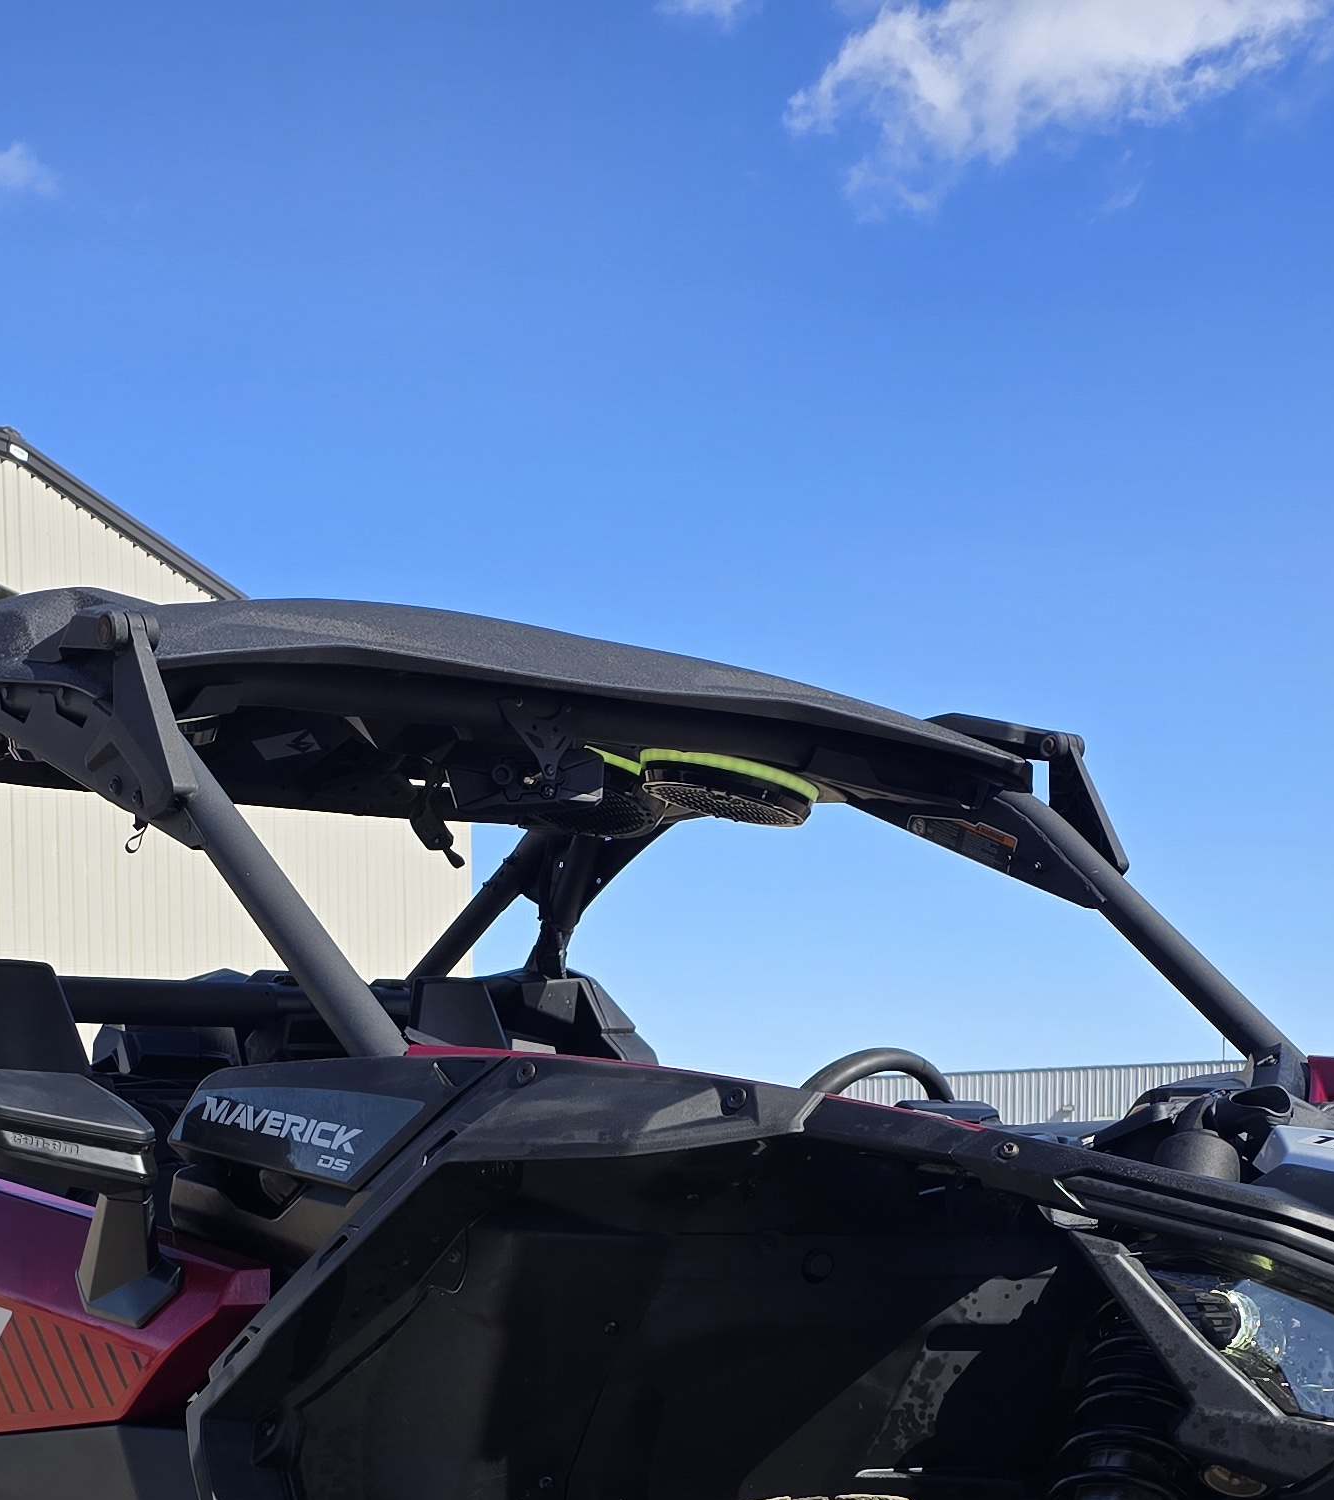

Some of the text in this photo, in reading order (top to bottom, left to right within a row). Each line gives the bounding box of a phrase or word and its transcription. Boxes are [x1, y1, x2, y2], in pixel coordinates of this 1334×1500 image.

[201, 1096, 364, 1155] MAVERICK
[13, 1132, 80, 1155] can-am
[317, 1154, 351, 1172] DS
